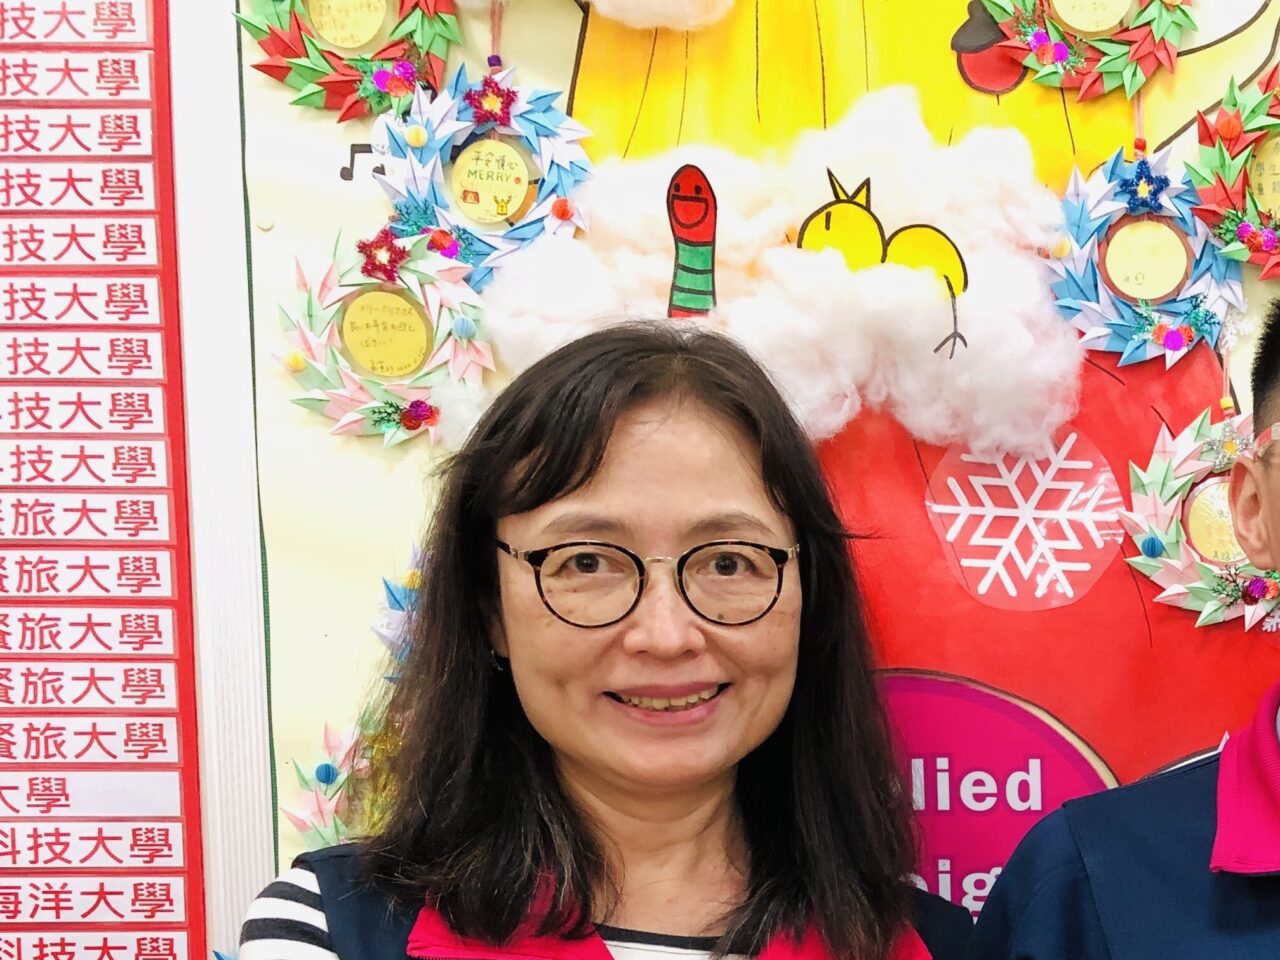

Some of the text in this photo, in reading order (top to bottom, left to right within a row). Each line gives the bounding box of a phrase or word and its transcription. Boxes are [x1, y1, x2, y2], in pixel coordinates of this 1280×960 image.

[0, 115, 141, 152] 技大學
[0, 168, 143, 207] 技大學
[467, 169, 512, 183] MERRY
[3, 224, 145, 262] 技大學
[4, 283, 148, 321] 技大學
[7, 338, 151, 376] 技大學
[0, 499, 158, 537] 旅大學
[0, 556, 160, 593] 旅大學
[0, 613, 162, 651] 旅大學
